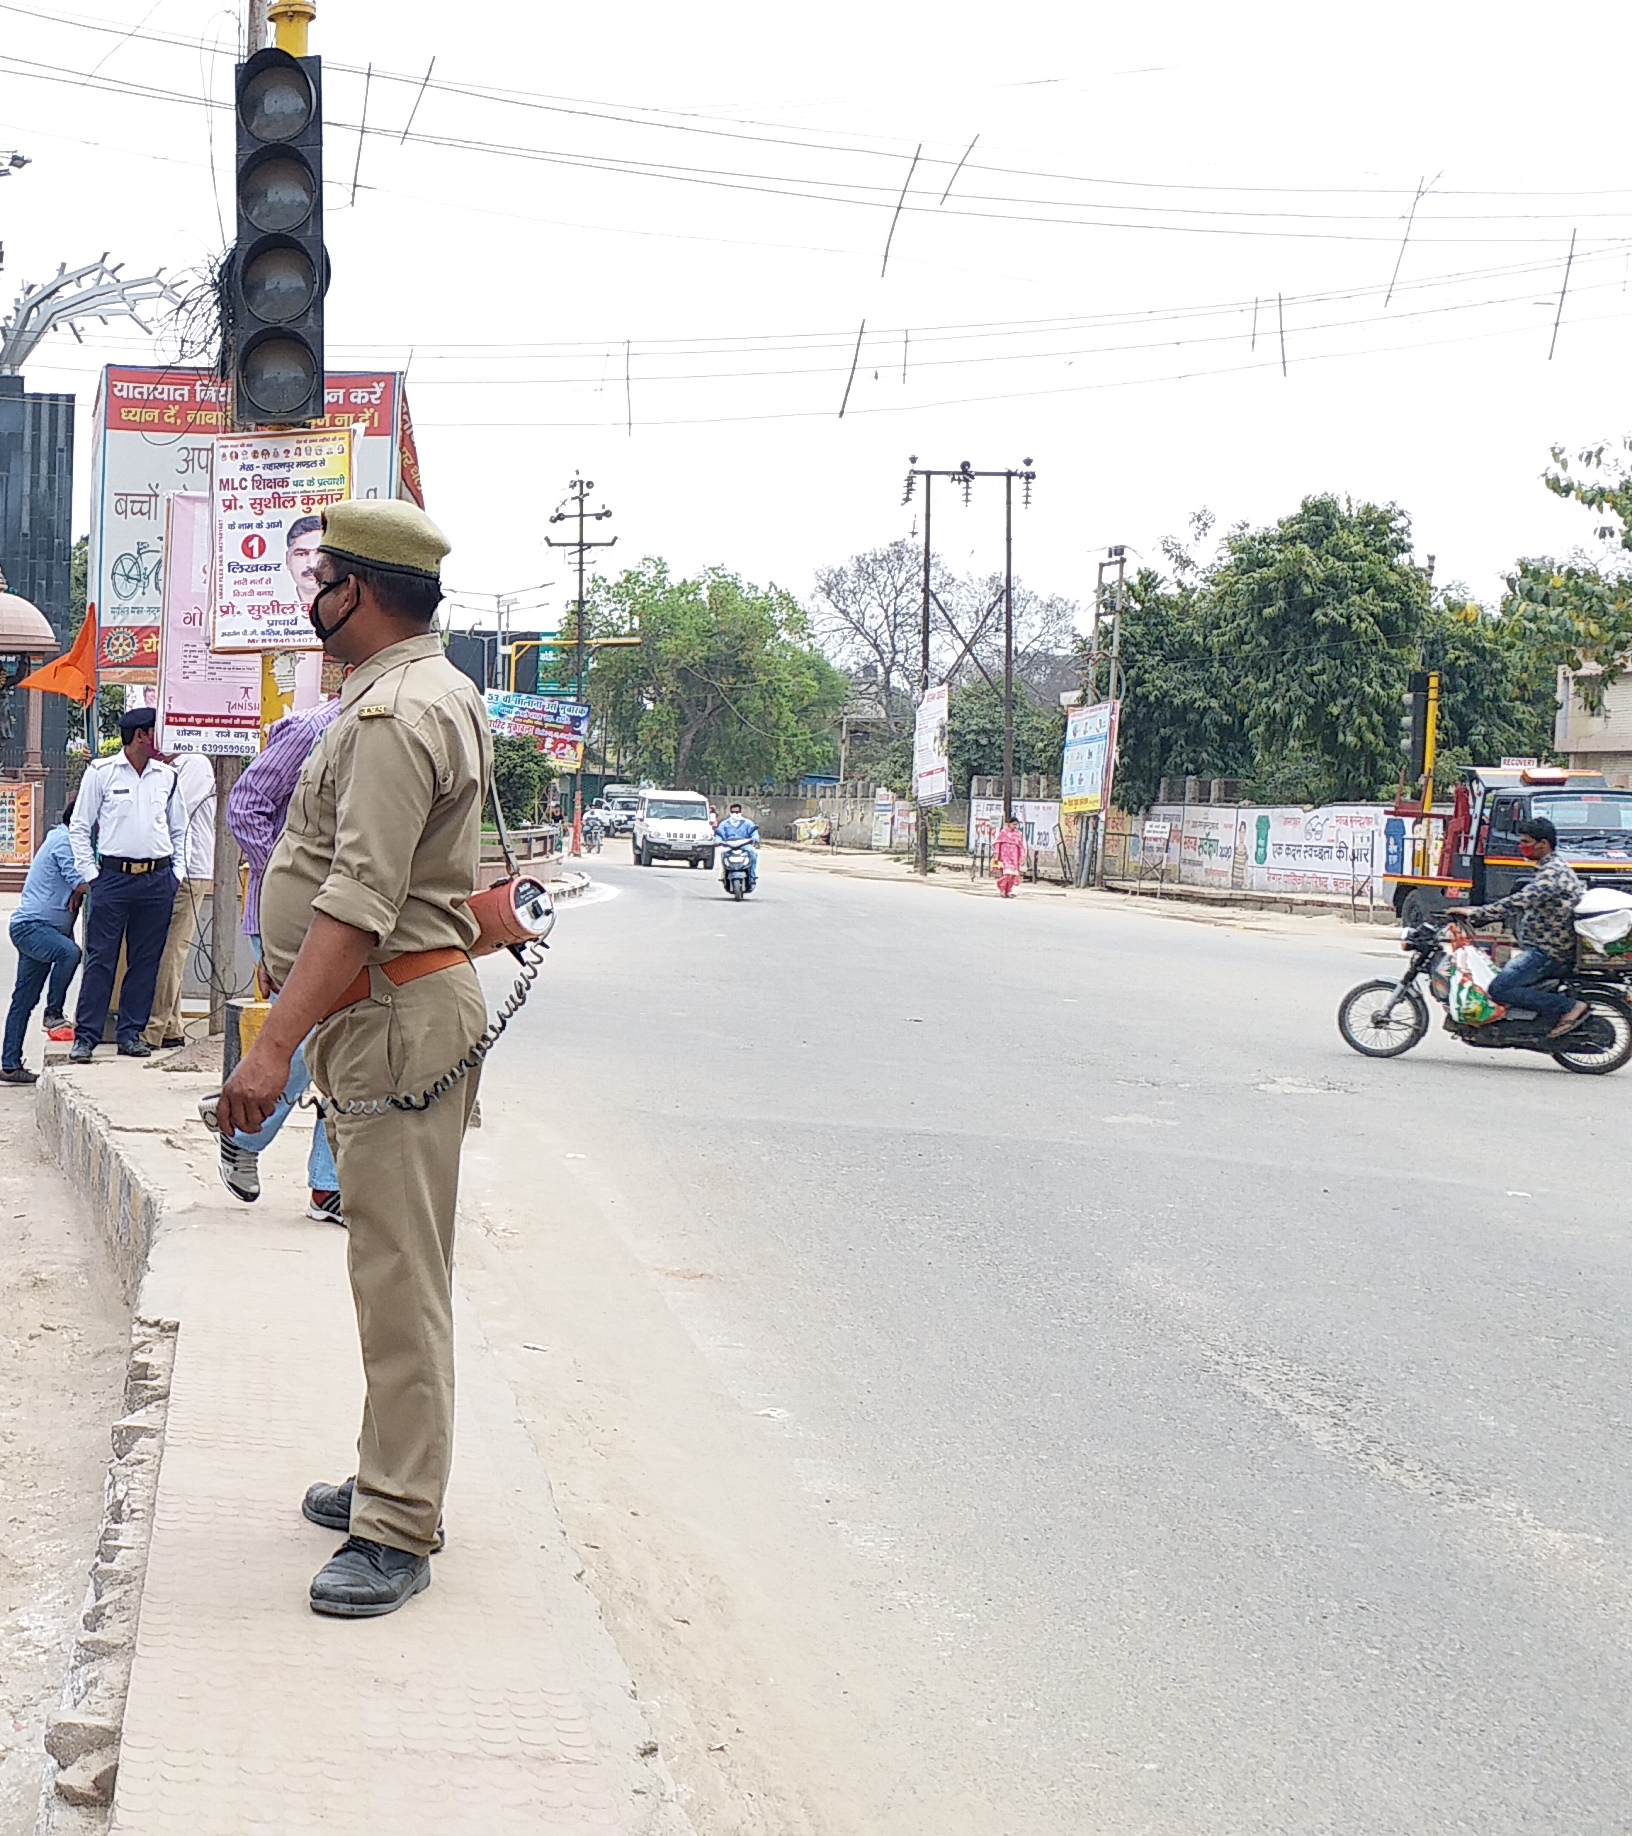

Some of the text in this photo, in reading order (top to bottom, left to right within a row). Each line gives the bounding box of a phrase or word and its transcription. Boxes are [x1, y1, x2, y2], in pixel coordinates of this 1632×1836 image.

[112, 379, 385, 405] यातायात निय न करें
[121, 407, 160, 423] ध्यान
[176, 443, 213, 475] अप
[319, 457, 325, 467] से
[219, 474, 345, 491] MLC शिक्षक पद के प्रत्याशी
[114, 483, 160, 521] बच्चों
[221, 492, 345, 516] प्रो. सुशील कुमार
[228, 520, 236, 529] के
[256, 520, 263, 529] के
[266, 519, 282, 528] आगे
[248, 537, 260, 558] 1
[227, 562, 282, 573] लिखकर
[219, 601, 242, 617] प्रो.
[247, 600, 296, 620] सुशील
[266, 616, 298, 627] प्राचार्य
[173, 743, 193, 752] Mob
[1502, 757, 1536, 767] RECOVERY
[1272, 843, 1283, 859] एक
[1303, 845, 1334, 861] स्वच्छता
[1336, 841, 1348, 862] की
